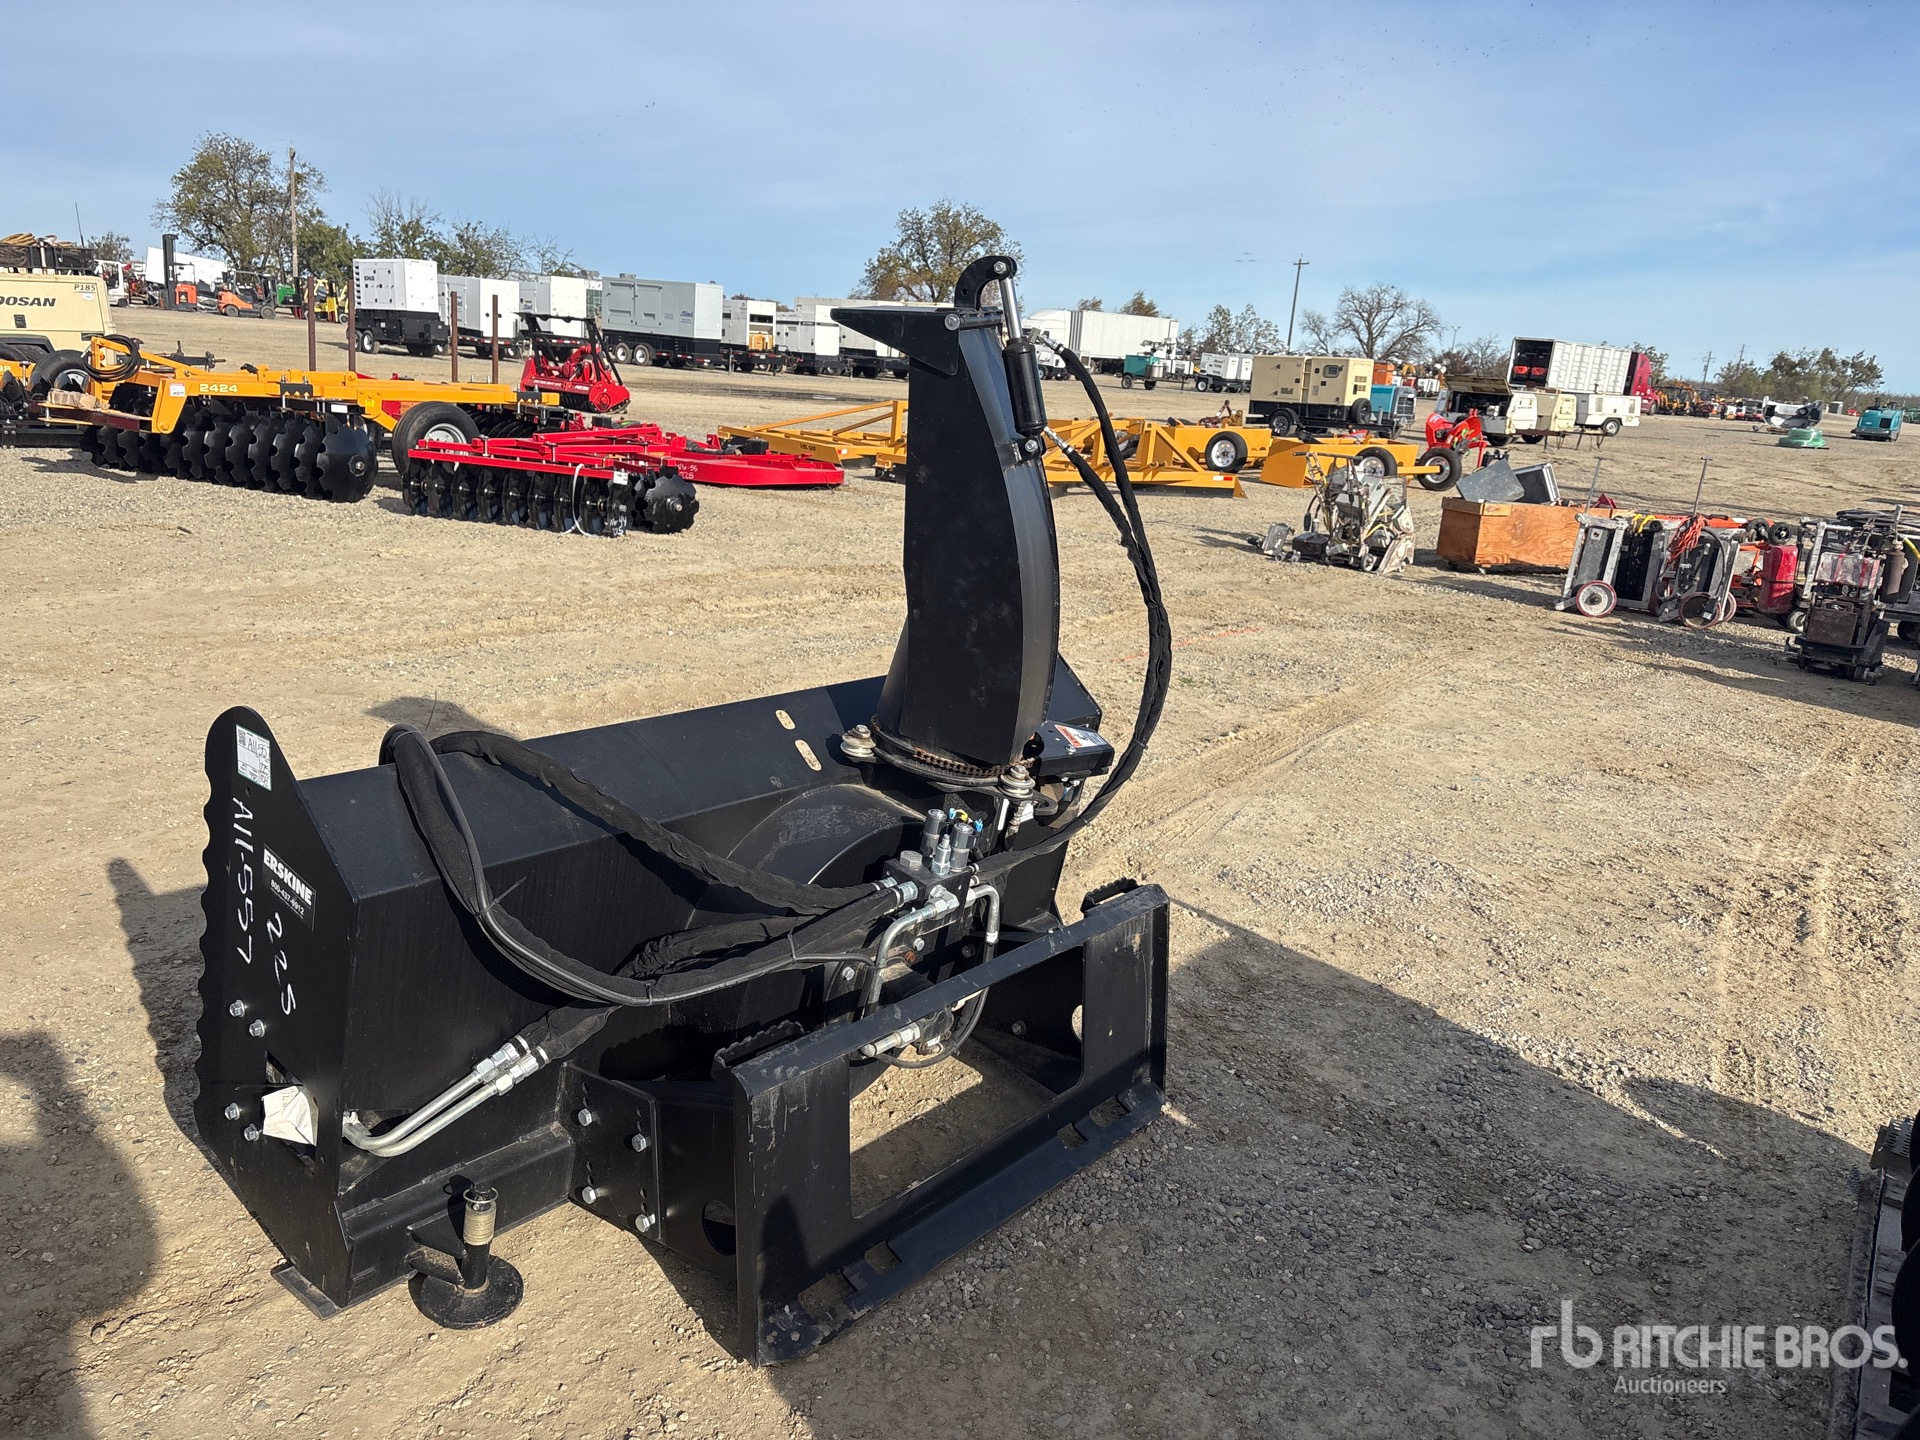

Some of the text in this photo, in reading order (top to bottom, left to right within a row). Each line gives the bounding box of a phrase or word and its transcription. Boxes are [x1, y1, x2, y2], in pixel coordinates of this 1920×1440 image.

[199, 383, 239, 393] 2424
[233, 797, 254, 965] A11-557
[263, 848, 313, 907] ERSKINE
[270, 879, 305, 916] 800-437-6912
[267, 911, 297, 1016] 225
